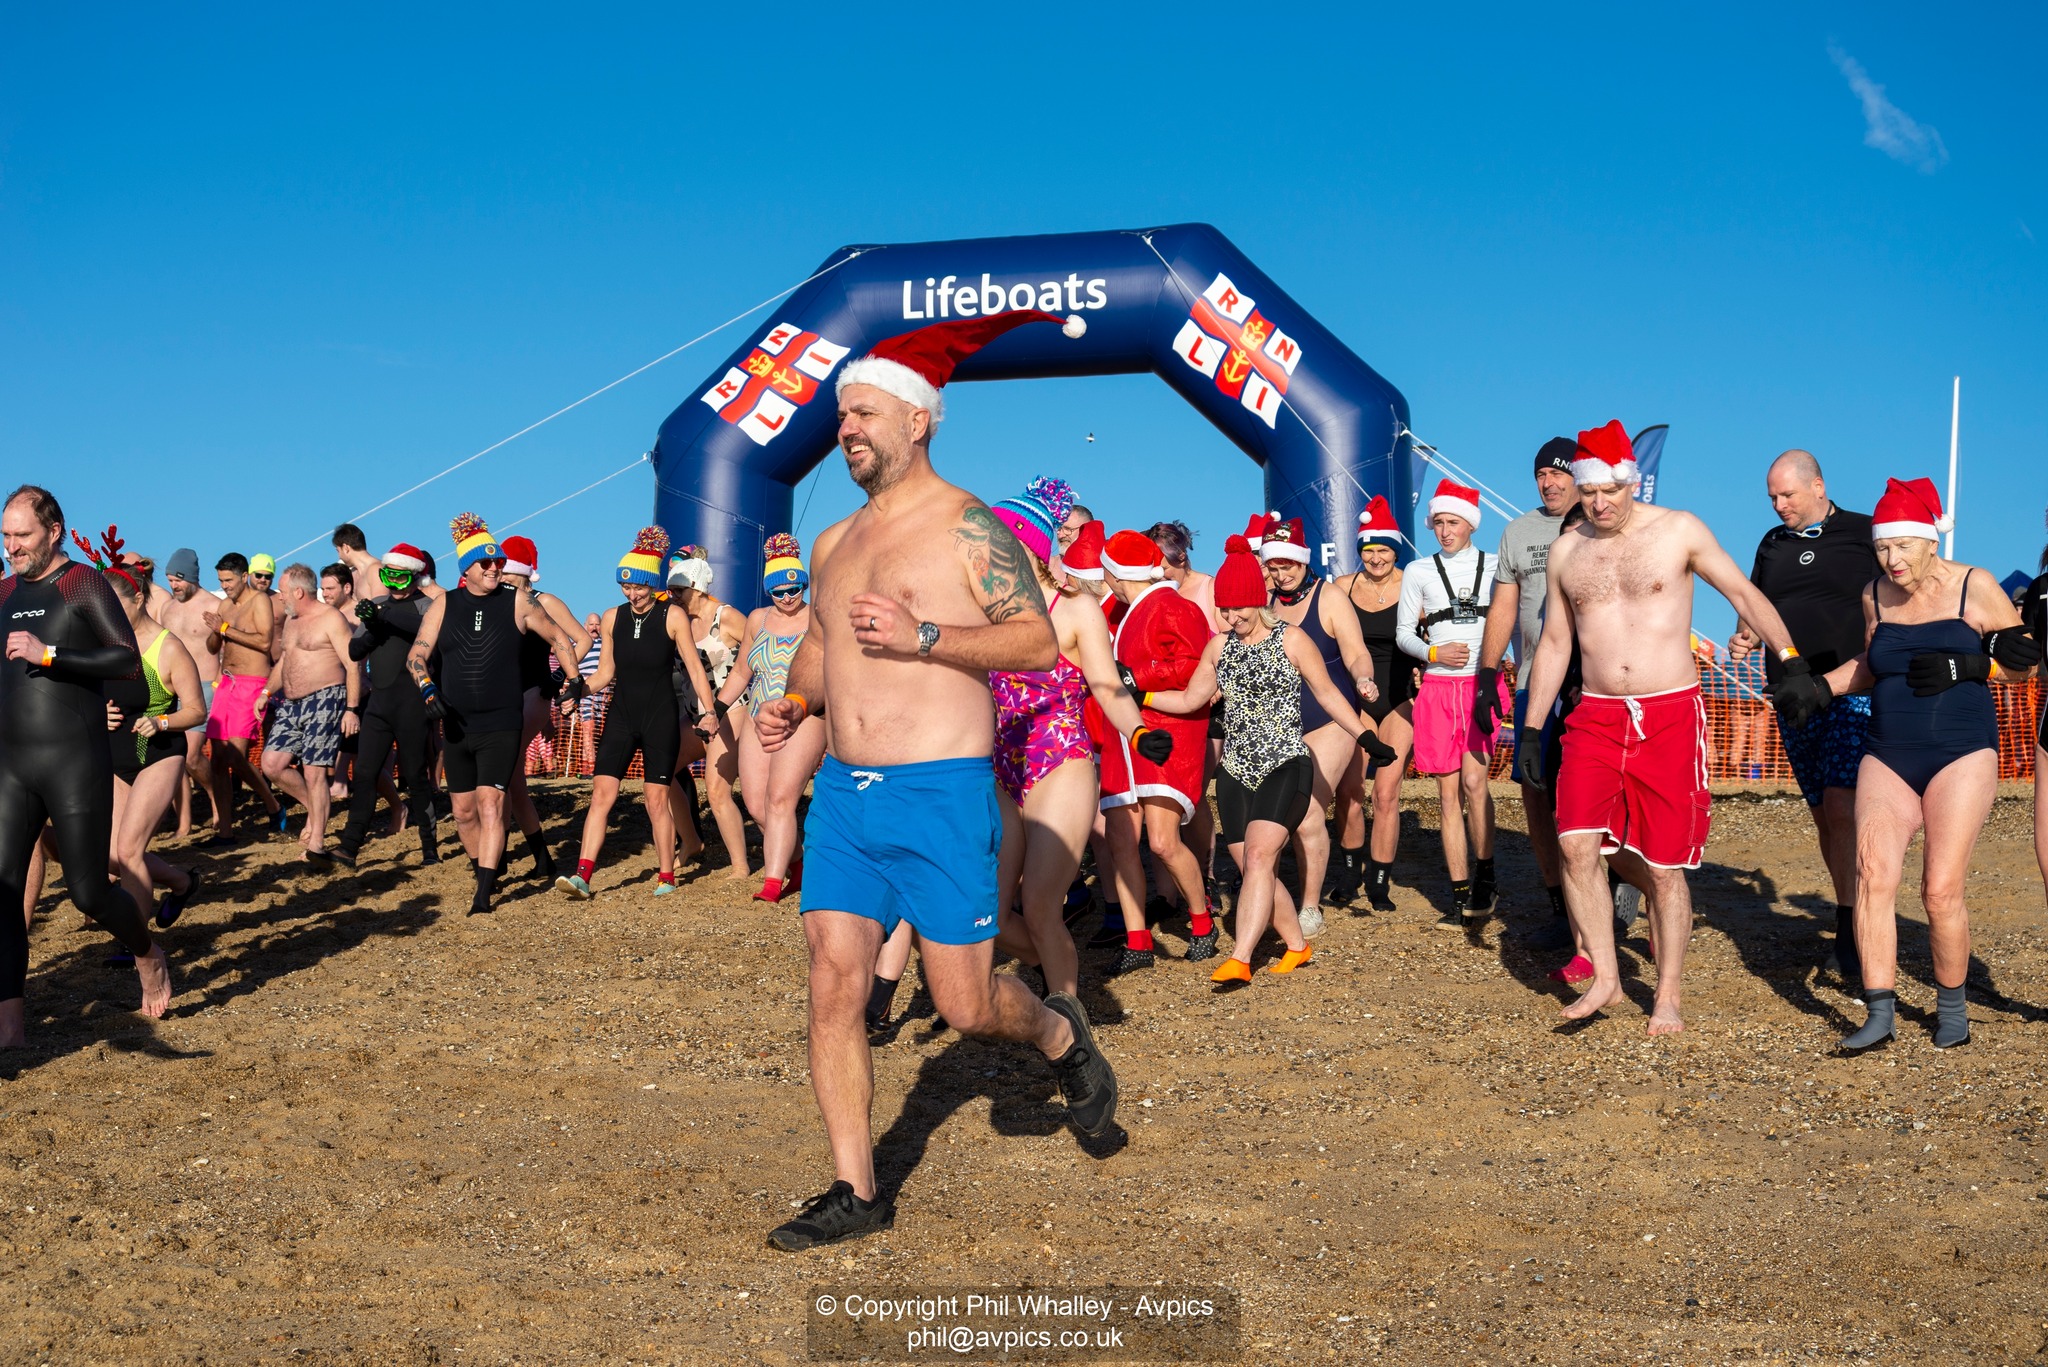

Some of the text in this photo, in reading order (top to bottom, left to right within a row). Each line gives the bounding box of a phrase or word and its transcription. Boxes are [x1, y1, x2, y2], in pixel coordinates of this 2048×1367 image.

[902, 273, 1108, 320] Lifeboats
[11, 609, 46, 619] orca
[474, 610, 483, 631] HUUB
[974, 915, 993, 928] FILA
